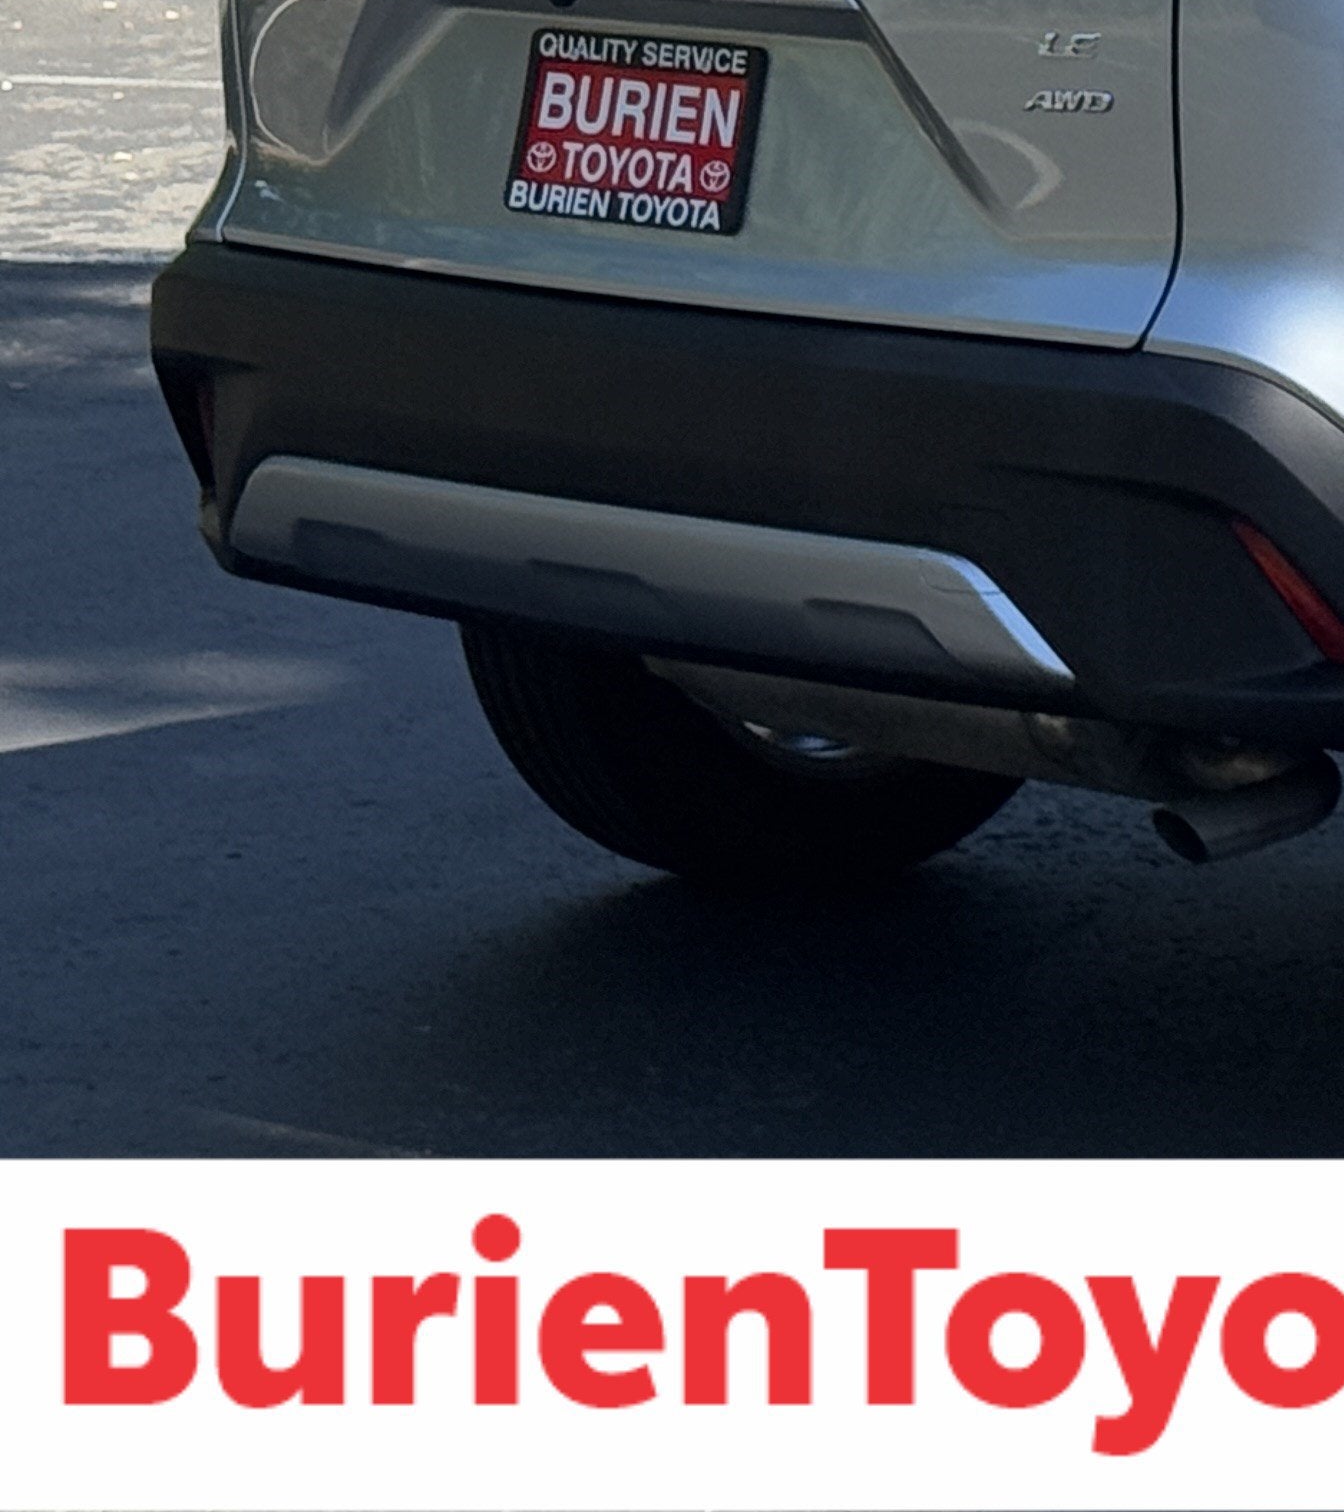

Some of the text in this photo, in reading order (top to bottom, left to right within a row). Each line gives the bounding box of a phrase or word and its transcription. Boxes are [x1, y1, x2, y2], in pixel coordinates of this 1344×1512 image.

[538, 32, 750, 75] QUALITY SERVICE
[1037, 31, 1102, 58] LE
[536, 70, 742, 149] BURIEN
[1023, 89, 1114, 113] AWD
[562, 140, 694, 195] TOYOTA
[507, 179, 722, 232] BURIEN TOYOTA
